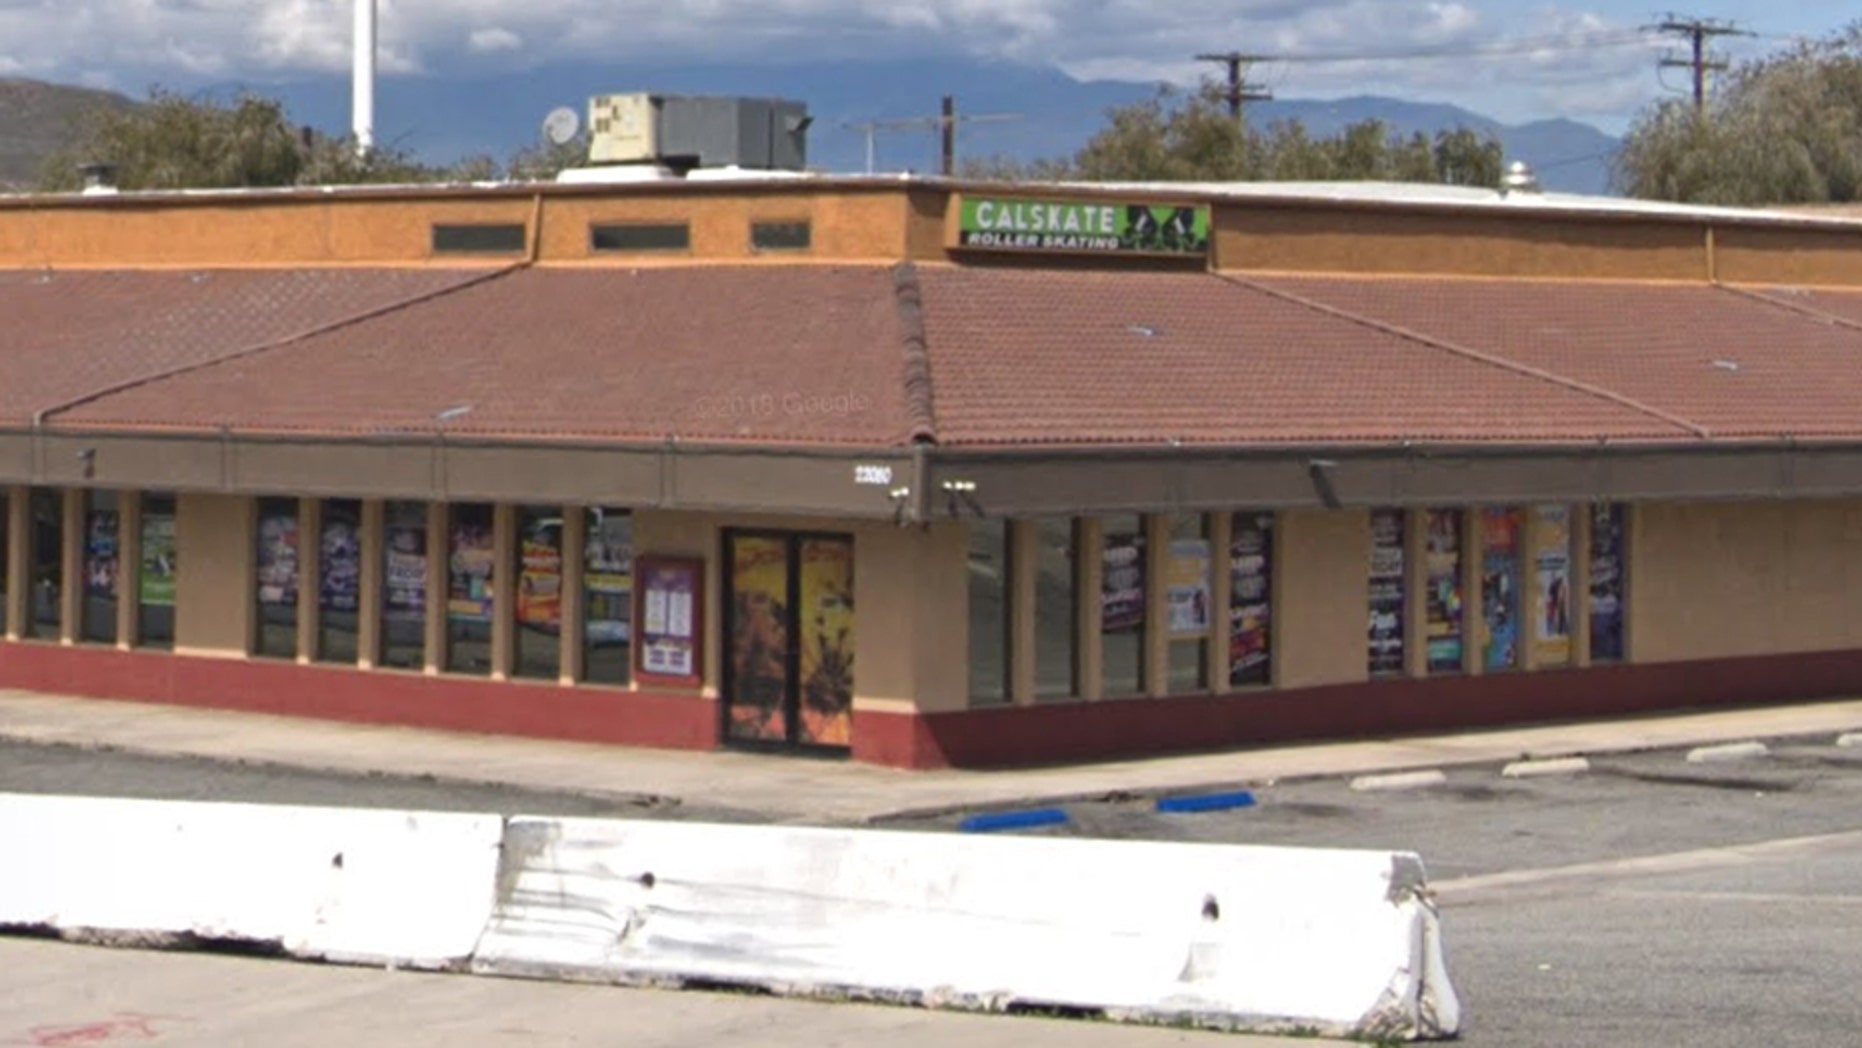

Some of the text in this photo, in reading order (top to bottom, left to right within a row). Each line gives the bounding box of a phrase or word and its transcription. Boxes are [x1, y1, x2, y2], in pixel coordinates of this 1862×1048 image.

[976, 202, 1115, 233] CALSKATE
[967, 232, 1120, 249] ROLLER SKATING
